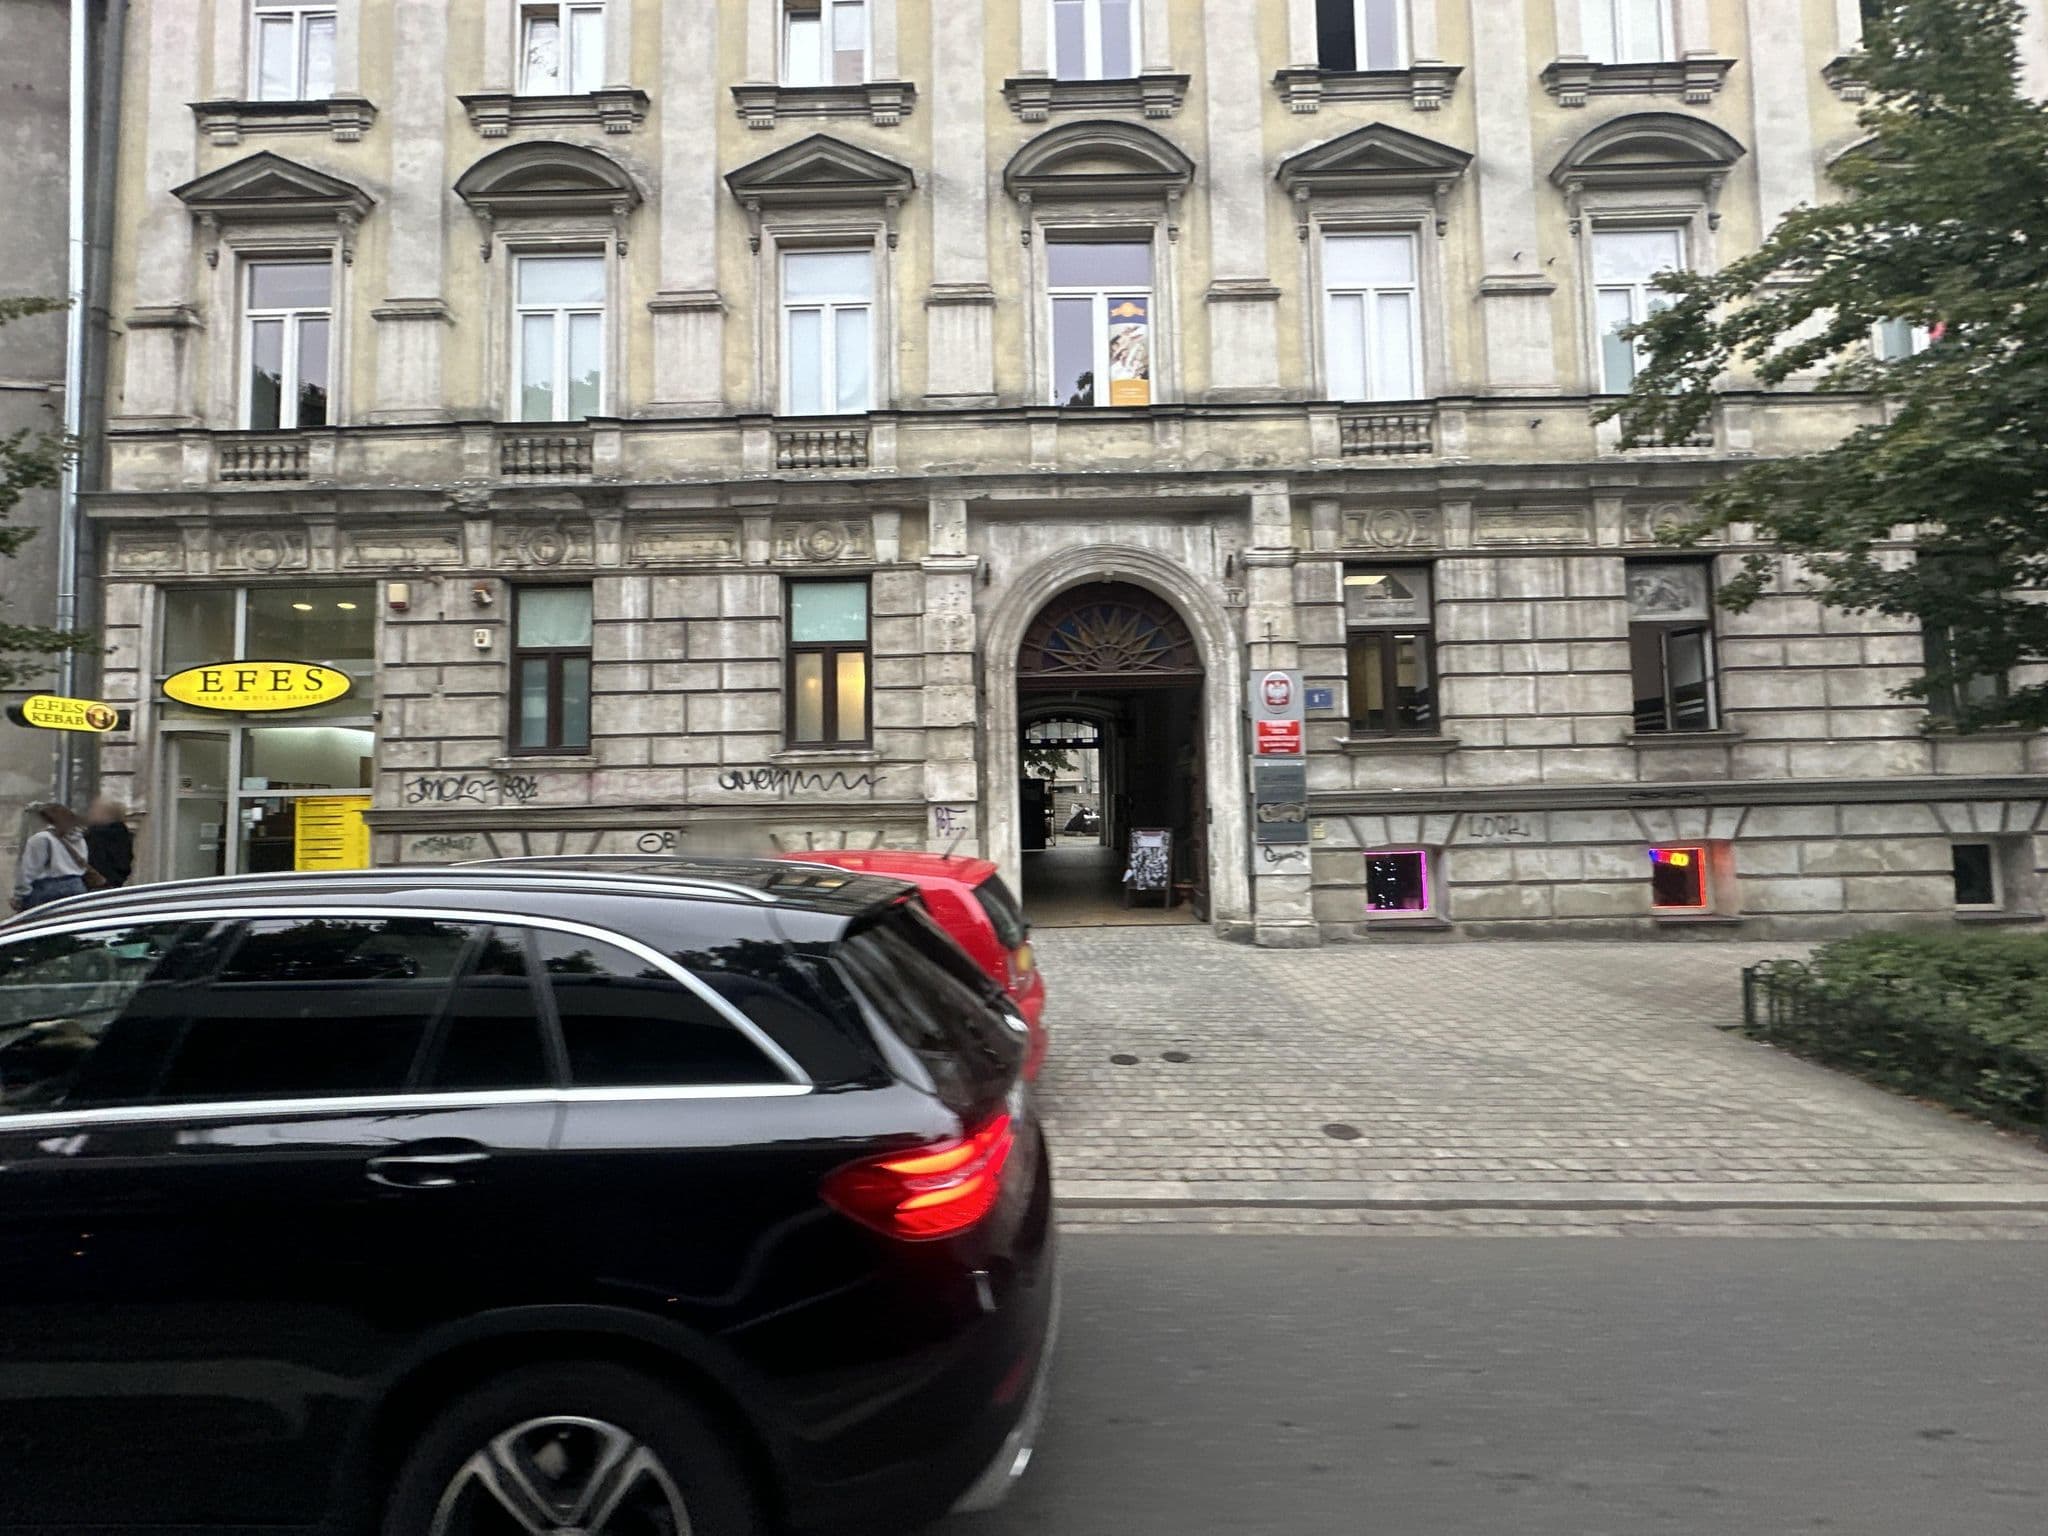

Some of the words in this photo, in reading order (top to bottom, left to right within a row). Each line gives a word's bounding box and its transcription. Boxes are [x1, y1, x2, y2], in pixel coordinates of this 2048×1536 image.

[196, 668, 324, 693] EFES
[31, 698, 84, 714] EFES
[31, 712, 84, 725] KEBAB
